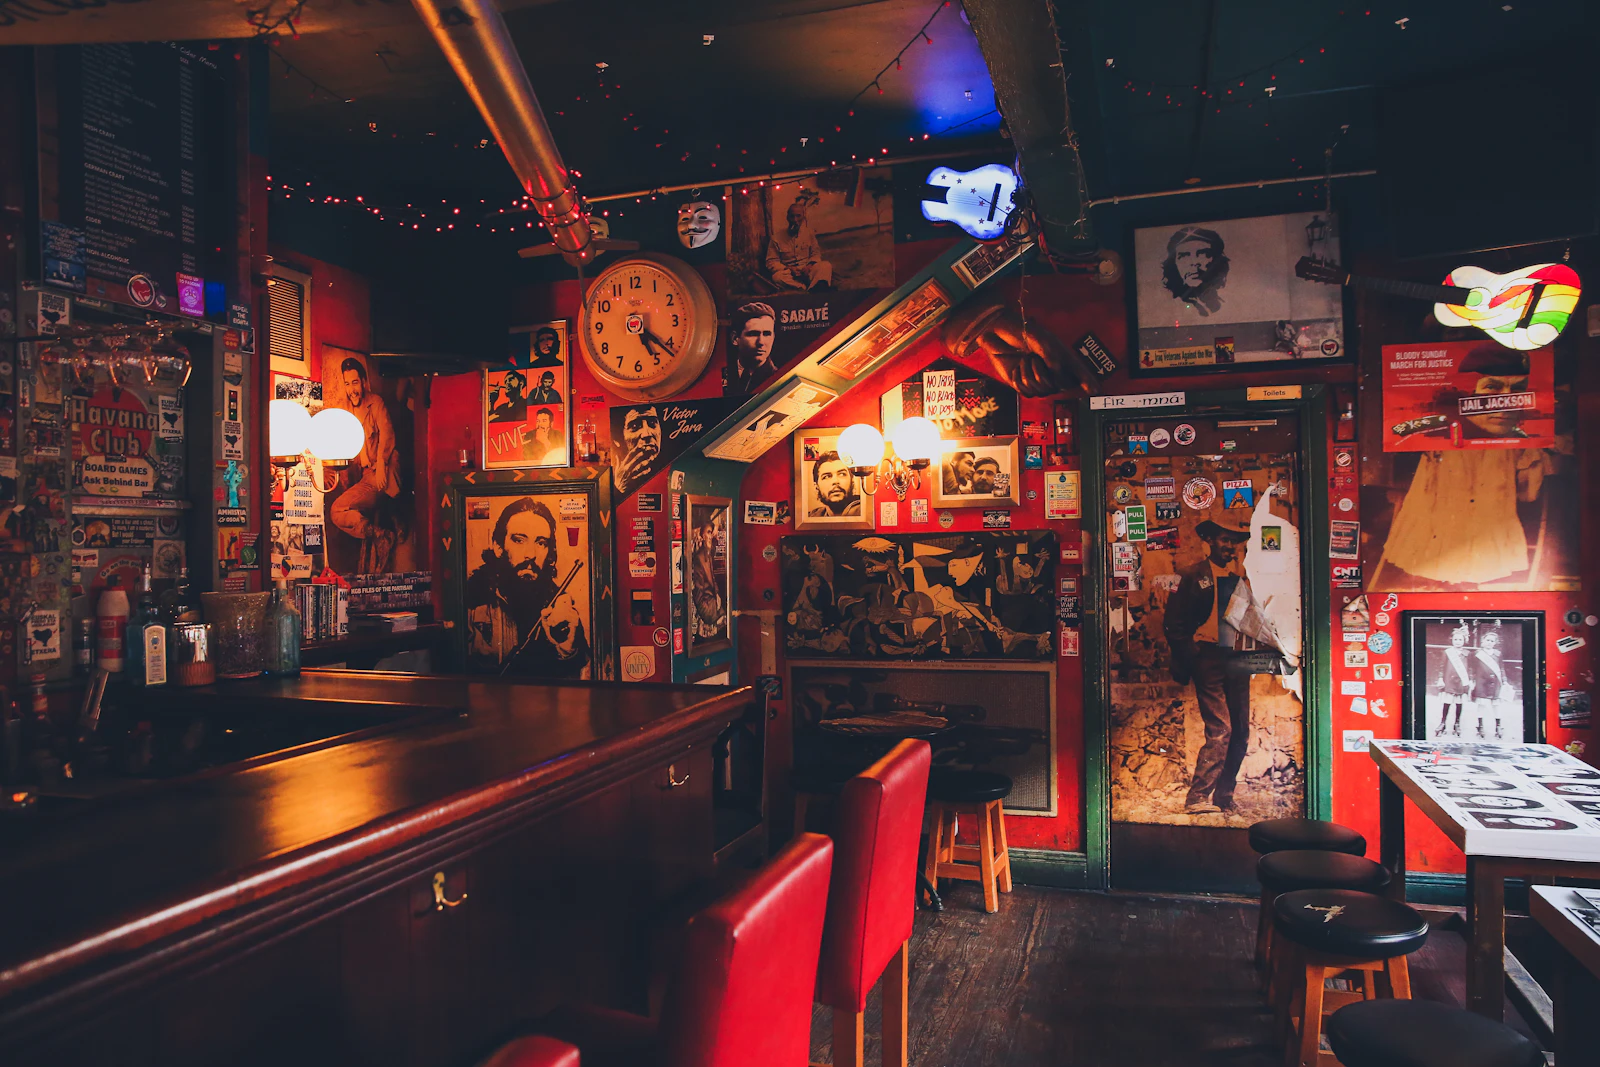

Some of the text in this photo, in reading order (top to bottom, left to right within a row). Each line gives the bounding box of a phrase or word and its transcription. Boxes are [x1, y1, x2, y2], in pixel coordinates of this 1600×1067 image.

[630, 275, 642, 289] 12
[652, 279, 658, 292] 1
[612, 283, 623, 298] 11
[598, 299, 612, 314] 10
[665, 293, 675, 307] 2
[780, 302, 830, 324] SABATÉ
[595, 321, 604, 335] 9
[671, 314, 680, 328] 3
[601, 342, 610, 355] 8
[664, 335, 675, 349] 4
[651, 353, 661, 366] 5
[1395, 349, 1448, 361] BLOODY SUNDAY
[616, 356, 625, 369] 7
[633, 360, 643, 373] 6
[1390, 358, 1454, 370] MARCH FOR JUSTICE
[1262, 389, 1286, 398] Toilets
[1461, 394, 1532, 412] JAIL JACKSON
[71, 398, 160, 432] Havana
[662, 405, 699, 422] Victor
[668, 419, 704, 440] Jara
[90, 428, 143, 458] Club
[490, 423, 532, 456] VIVE
[85, 462, 149, 476] BOARD GAMES
[84, 475, 150, 488] Ask Behind Bar
[1225, 480, 1250, 489] PIZZA
[1146, 485, 1175, 495] AMNISTIA
[633, 654, 646, 663] YES
[626, 663, 650, 675] UNITY
